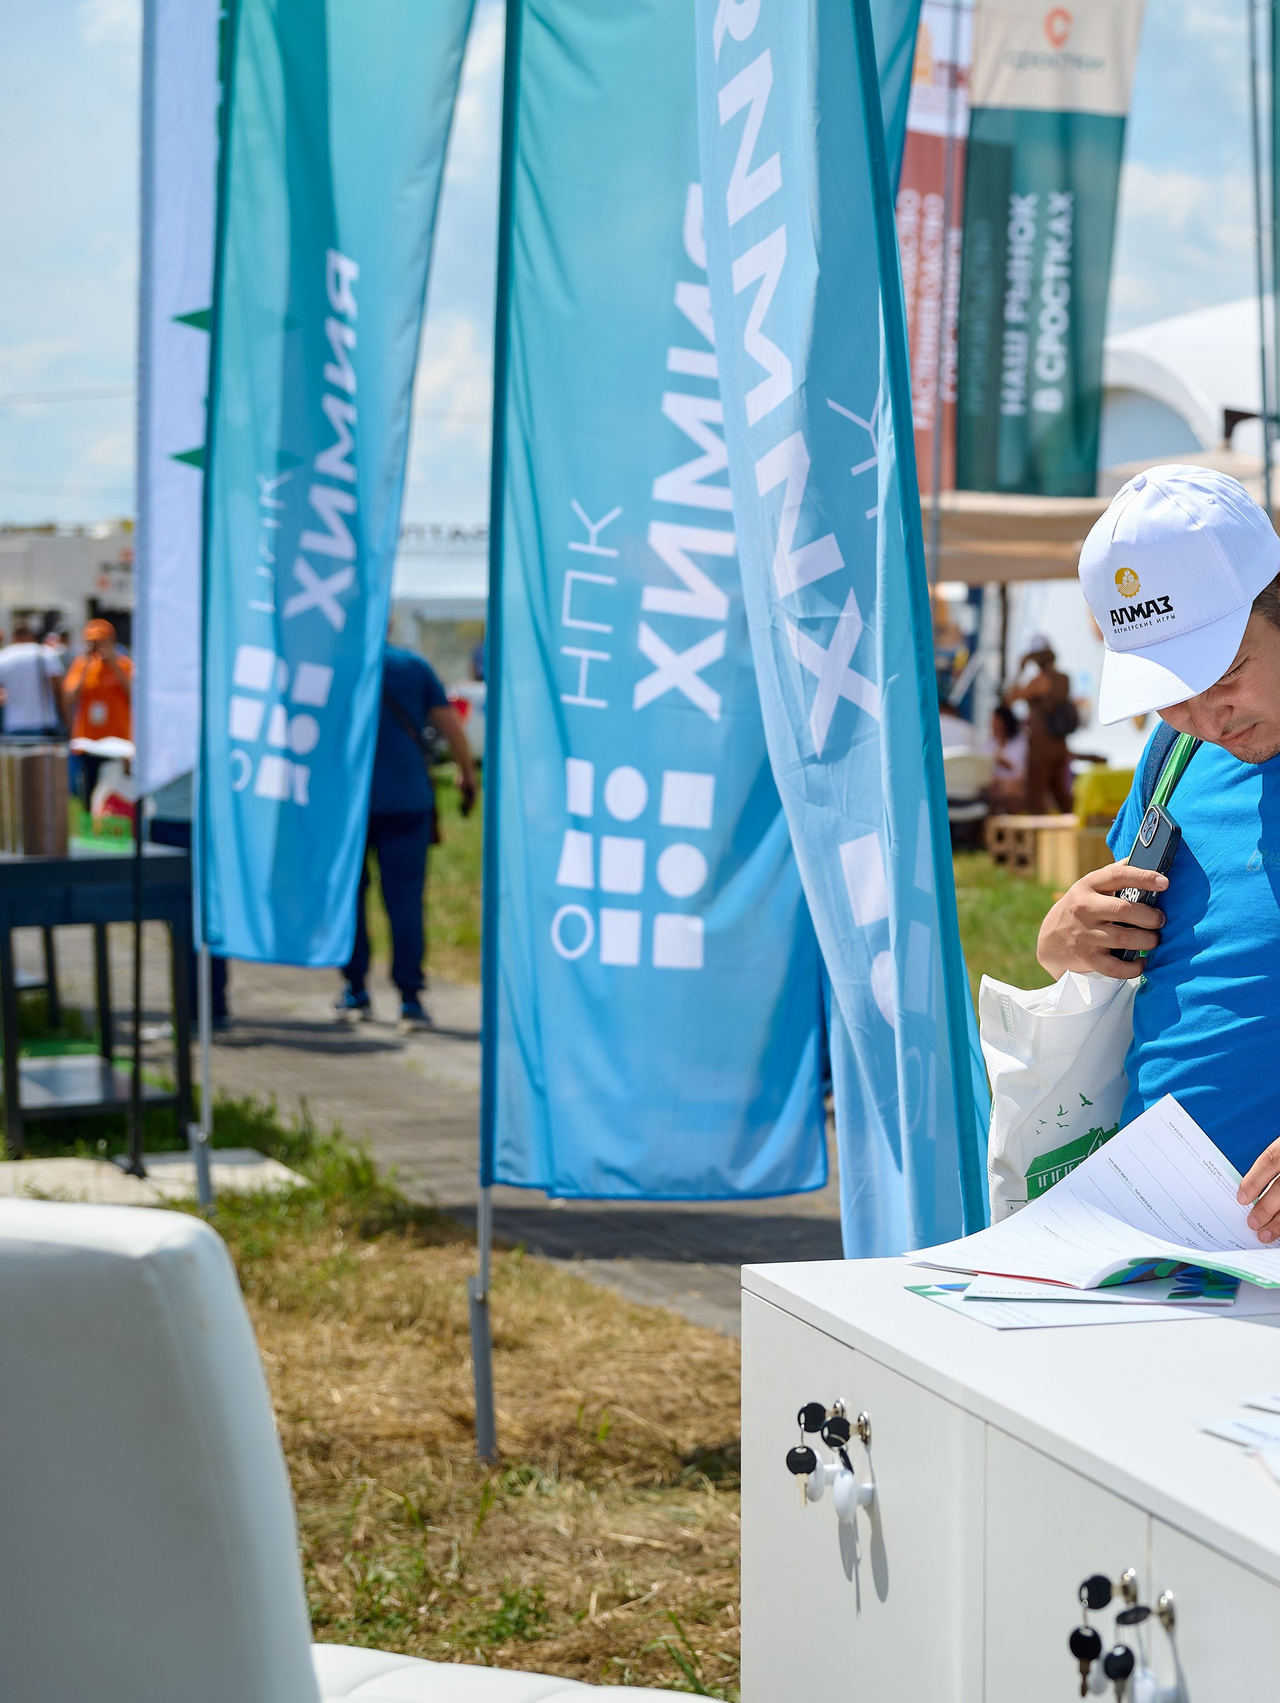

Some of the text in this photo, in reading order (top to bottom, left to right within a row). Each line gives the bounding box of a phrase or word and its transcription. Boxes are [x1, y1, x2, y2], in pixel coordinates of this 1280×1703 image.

[1000, 192, 1039, 417] НАШ РЫНОК
[1032, 190, 1074, 414] В СРОСТКАХ
[282, 247, 359, 633] ХИМИЯ
[560, 499, 623, 708] НПК
[1110, 595, 1173, 626] АЛМАЗ
[1114, 614, 1176, 634] ФЕРМЕРСКИЕ ИГРЫ
